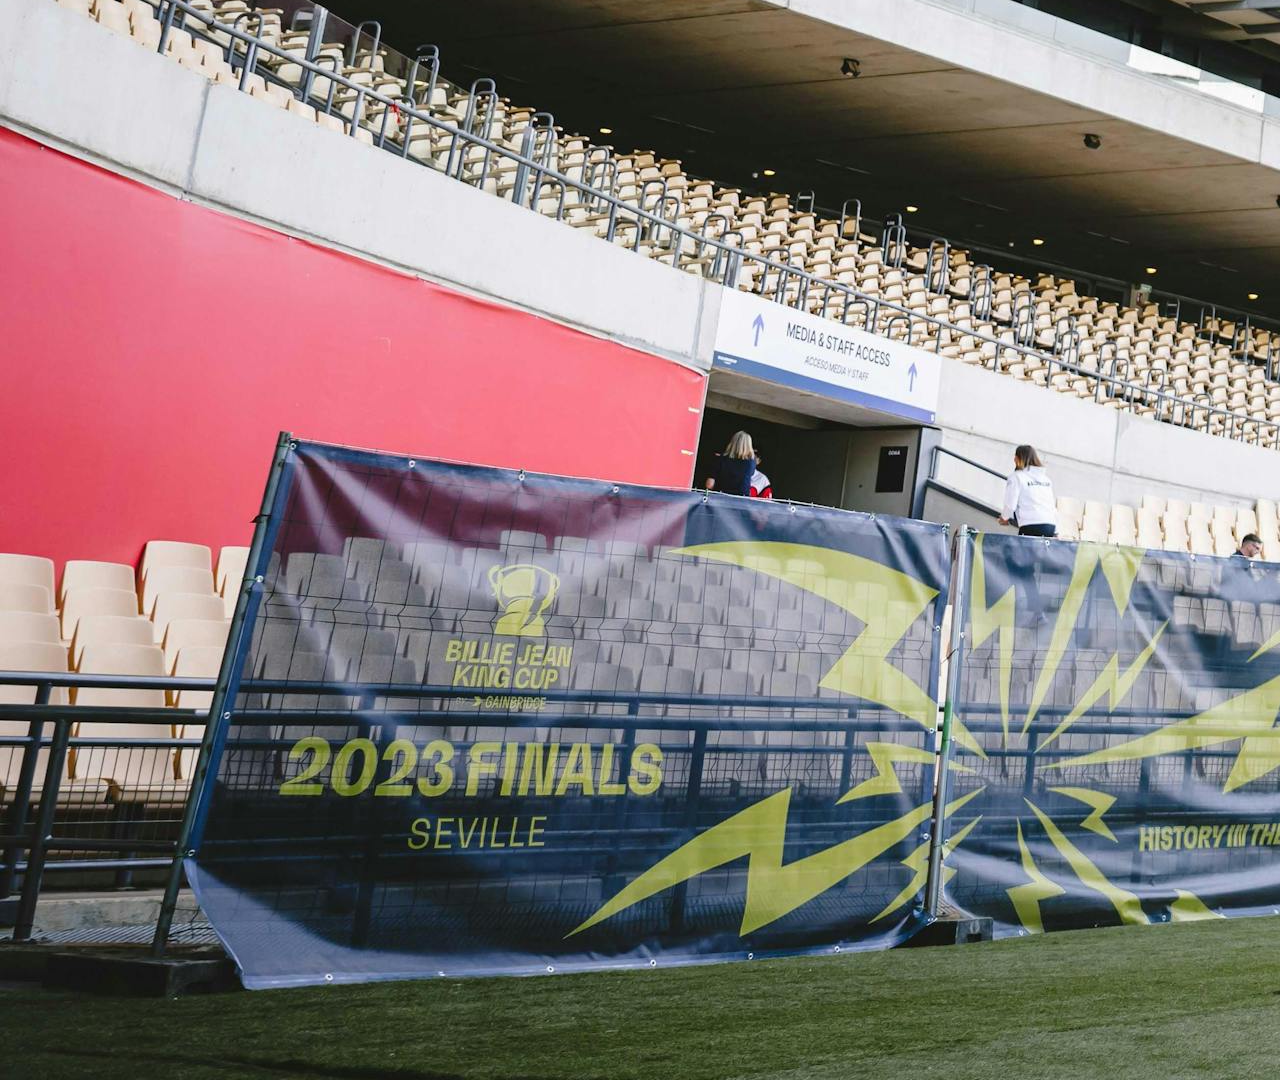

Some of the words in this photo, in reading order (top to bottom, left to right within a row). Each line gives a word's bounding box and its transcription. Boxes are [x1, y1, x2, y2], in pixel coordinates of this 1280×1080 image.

[786, 322, 816, 345] MEDIA
[818, 332, 825, 347] &
[826, 335, 855, 356] STAFF
[855, 345, 891, 367] ACCESS
[803, 355, 829, 370] ACCESO
[829, 363, 847, 376] MEDIA
[851, 369, 869, 381] STAFF
[445, 640, 516, 665] BILLIE
[517, 644, 573, 668] JEAN
[452, 664, 511, 689] KING
[514, 667, 559, 690] CUP
[485, 695, 547, 710] GAINBRIDGE
[279, 735, 455, 798] 2023
[464, 740, 664, 797] FINALS
[407, 815, 547, 850] SEVILLE
[1138, 824, 1228, 853] HISTORY
[1226, 823, 1250, 848] IN
